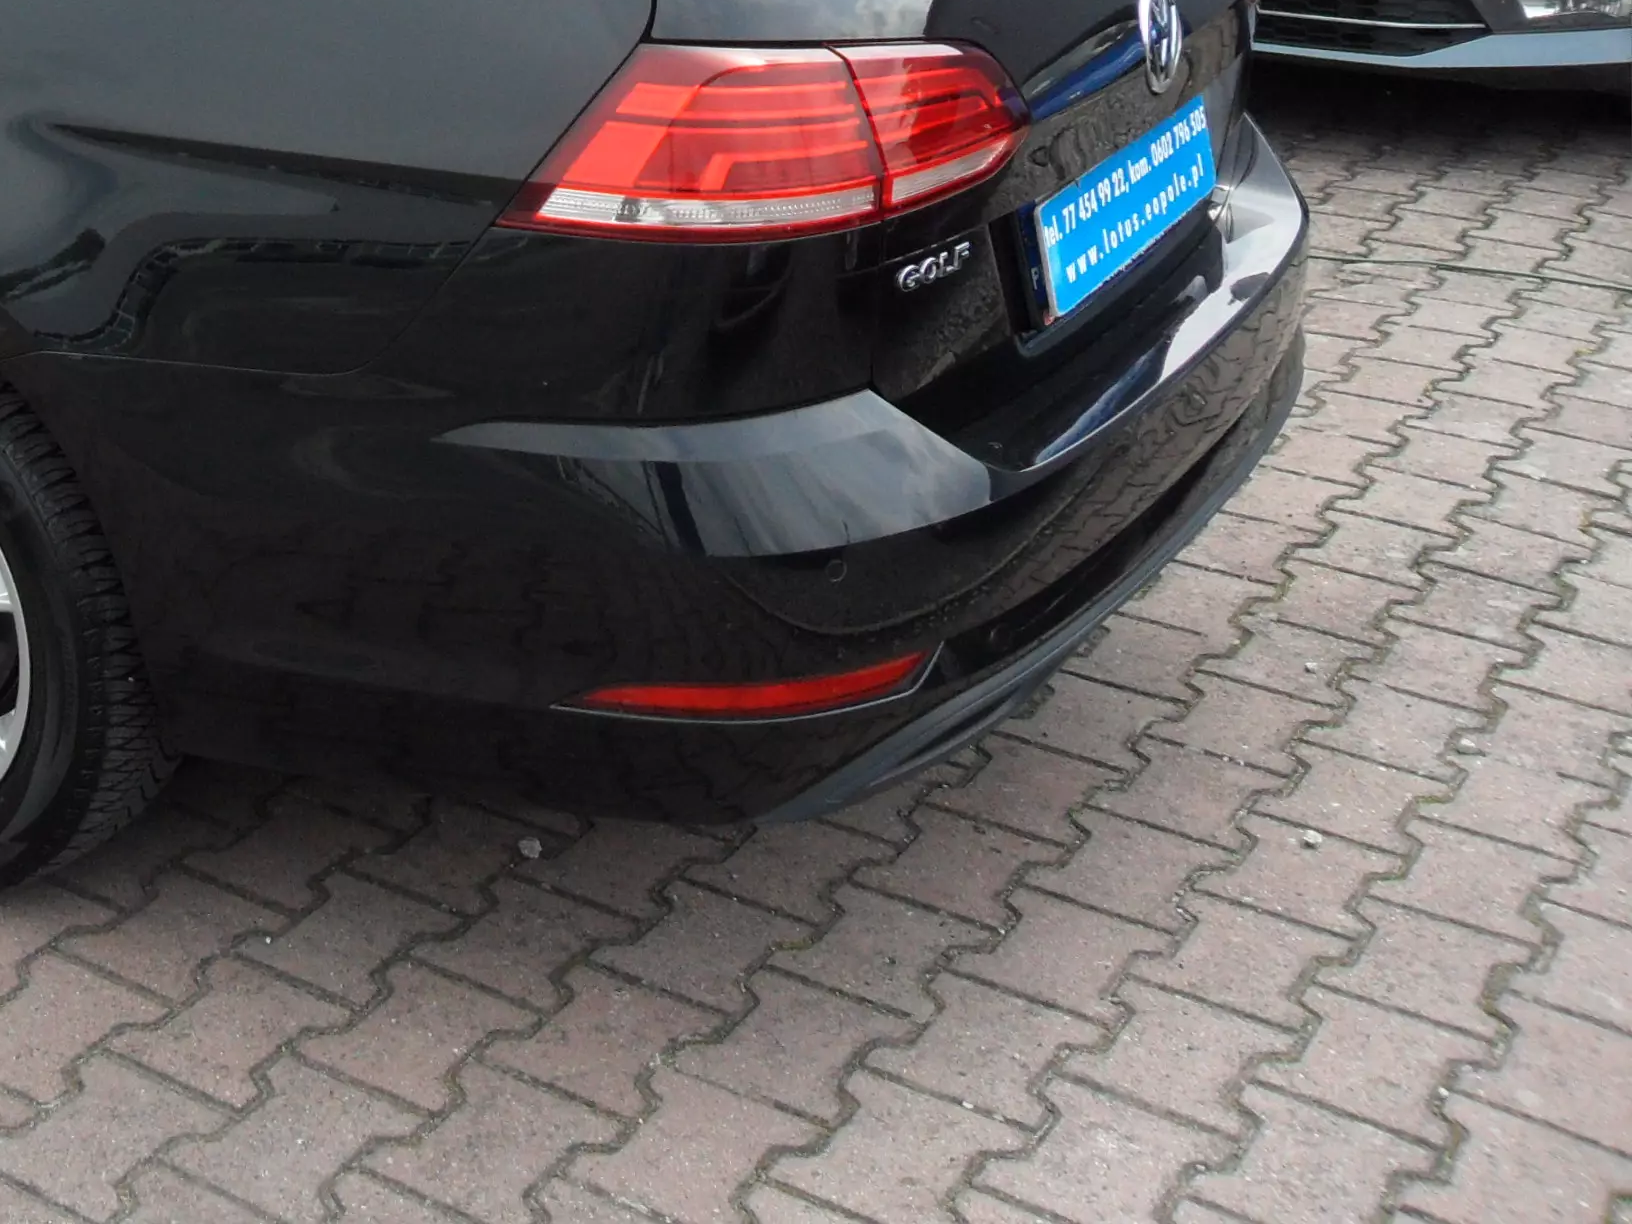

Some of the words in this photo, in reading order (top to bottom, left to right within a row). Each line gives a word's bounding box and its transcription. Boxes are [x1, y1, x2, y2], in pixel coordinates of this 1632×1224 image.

[1043, 214, 1064, 249] tel.
[1062, 203, 1076, 234] 77
[1078, 189, 1098, 222] 454
[1097, 177, 1112, 207] 99
[1127, 159, 1152, 185] kom.
[1150, 131, 1174, 167] 0602
[1172, 120, 1191, 150] 796
[896, 241, 971, 292] GOLF
